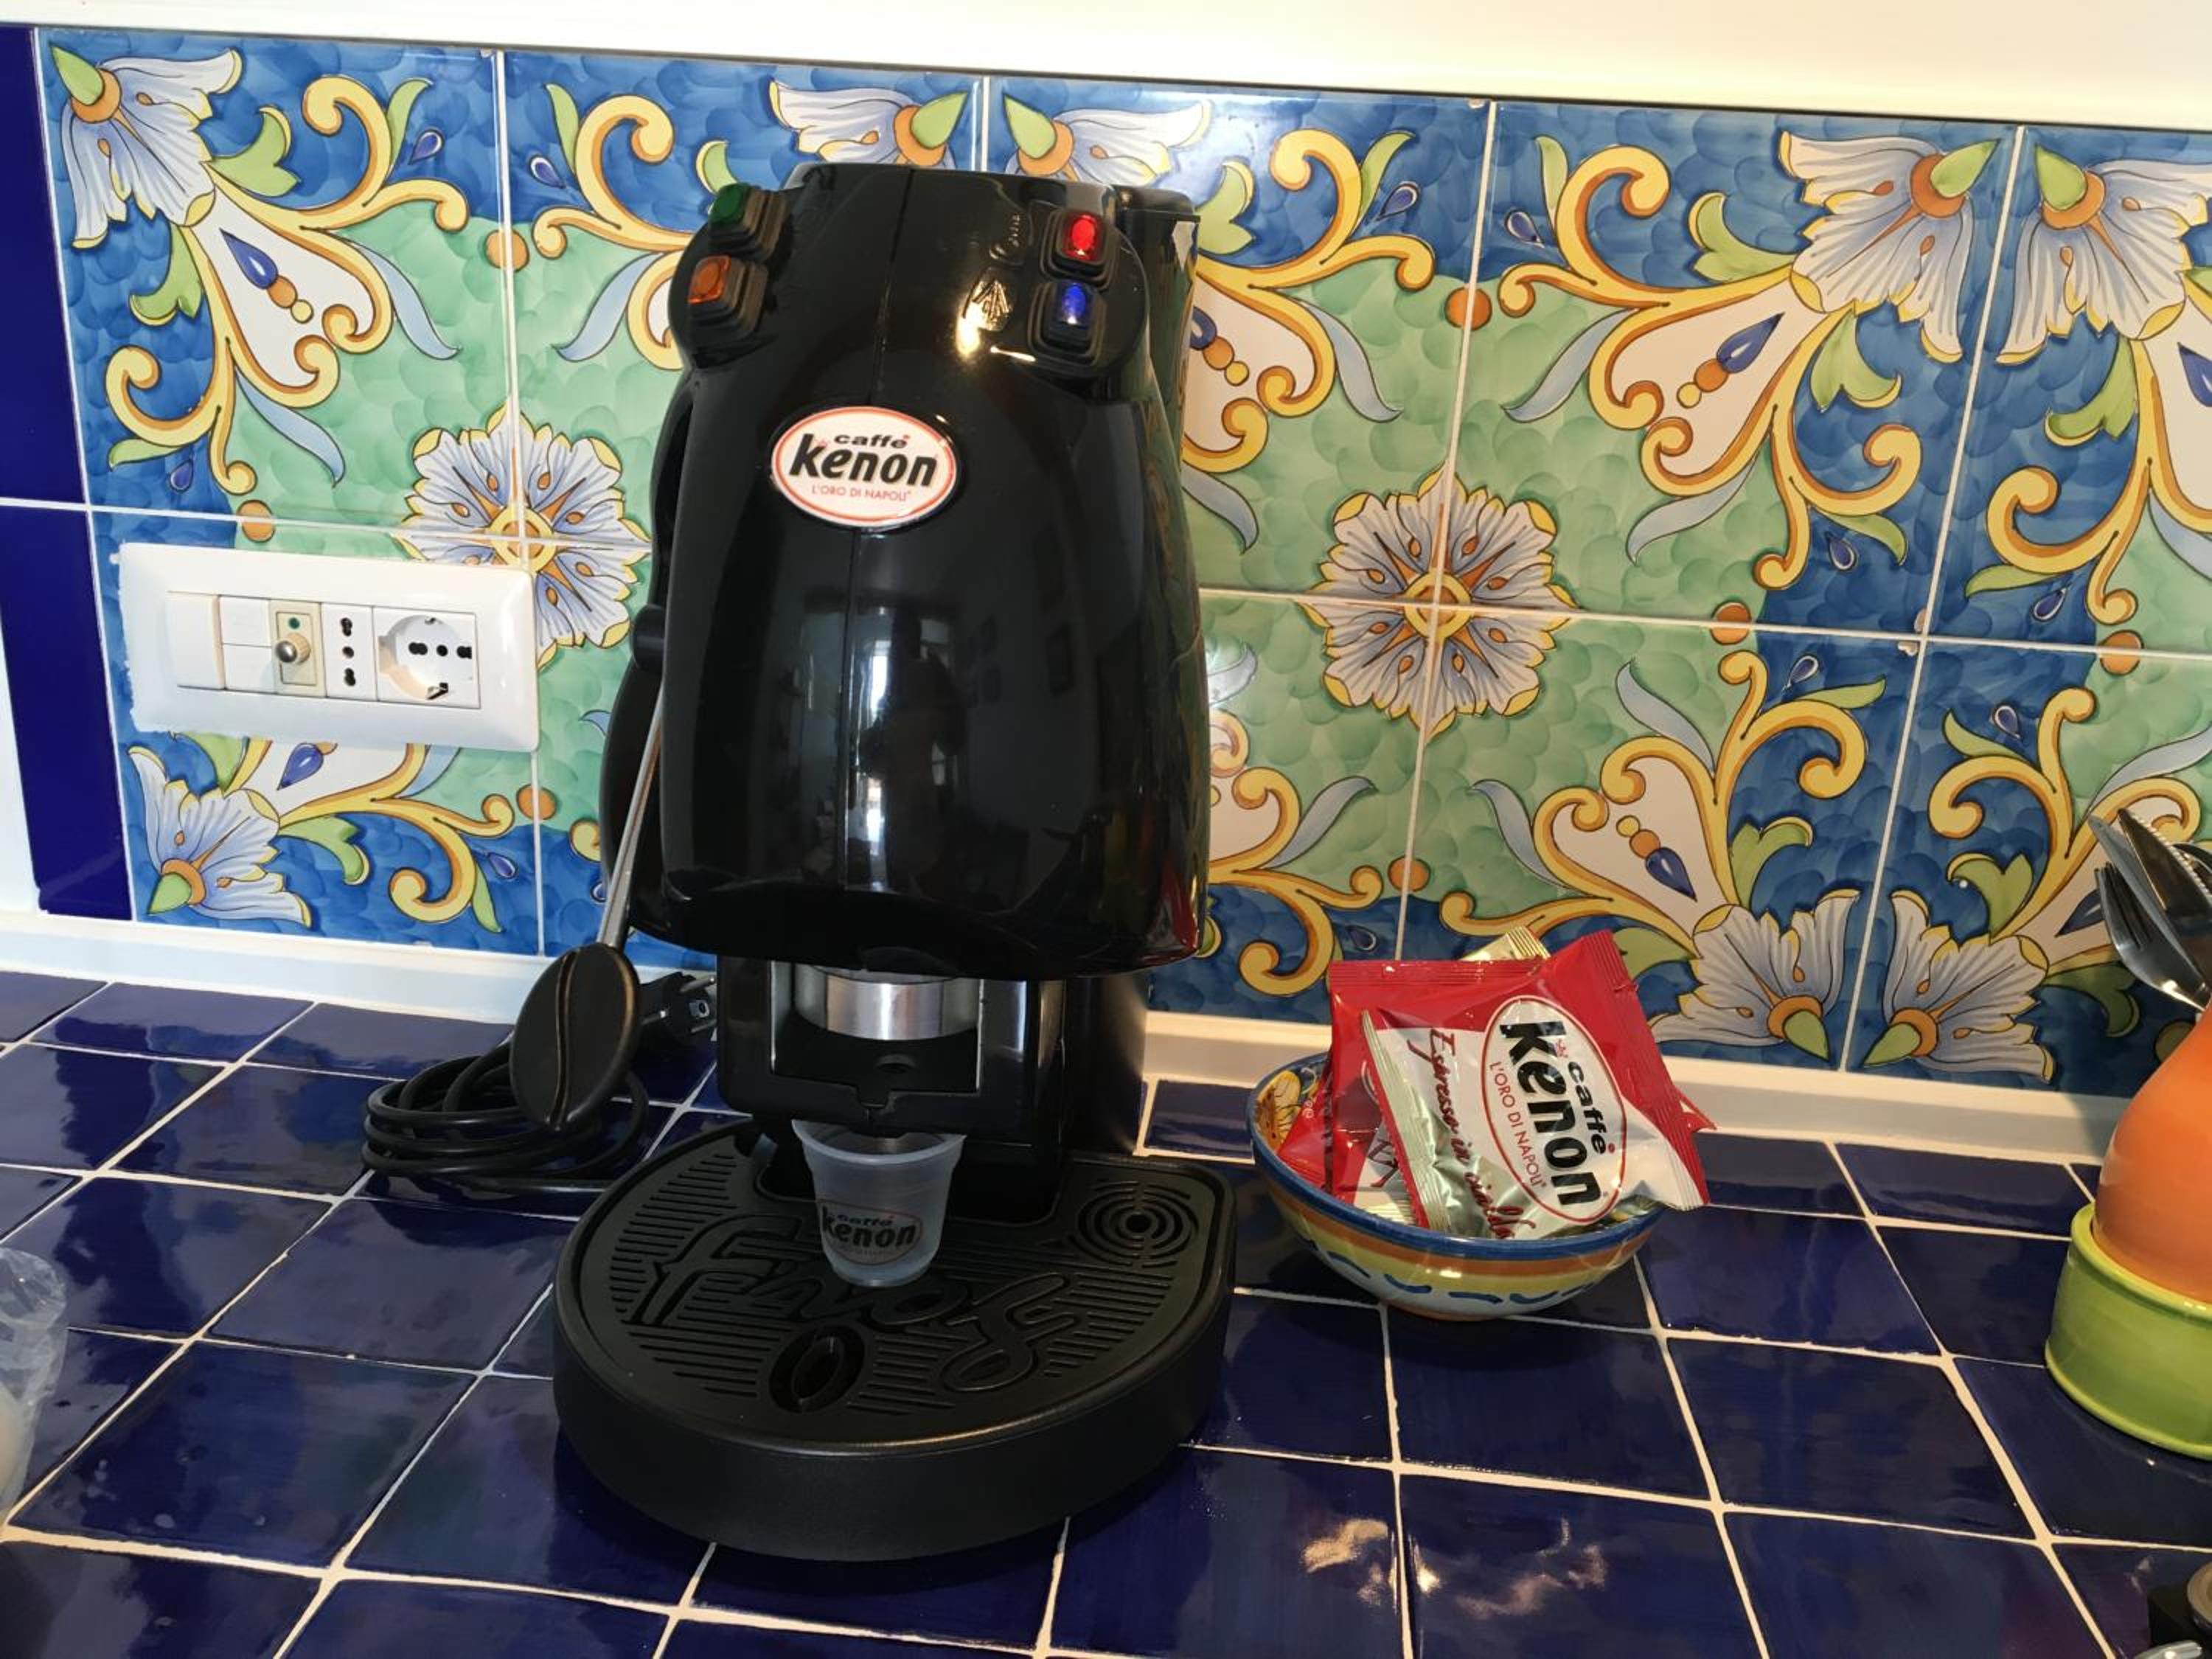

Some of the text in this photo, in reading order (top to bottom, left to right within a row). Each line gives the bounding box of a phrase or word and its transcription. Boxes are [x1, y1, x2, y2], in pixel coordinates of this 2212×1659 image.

[790, 434, 937, 487] kenon
[812, 485, 846, 496] L'ORO
[850, 489, 861, 497] DI
[1407, 1028, 1459, 1135] Espresso
[1489, 1061, 1515, 1110] L'ORO
[1507, 1111, 1524, 1127] DI
[1500, 1020, 1602, 1206] kenon
[822, 1204, 917, 1248] kenon
